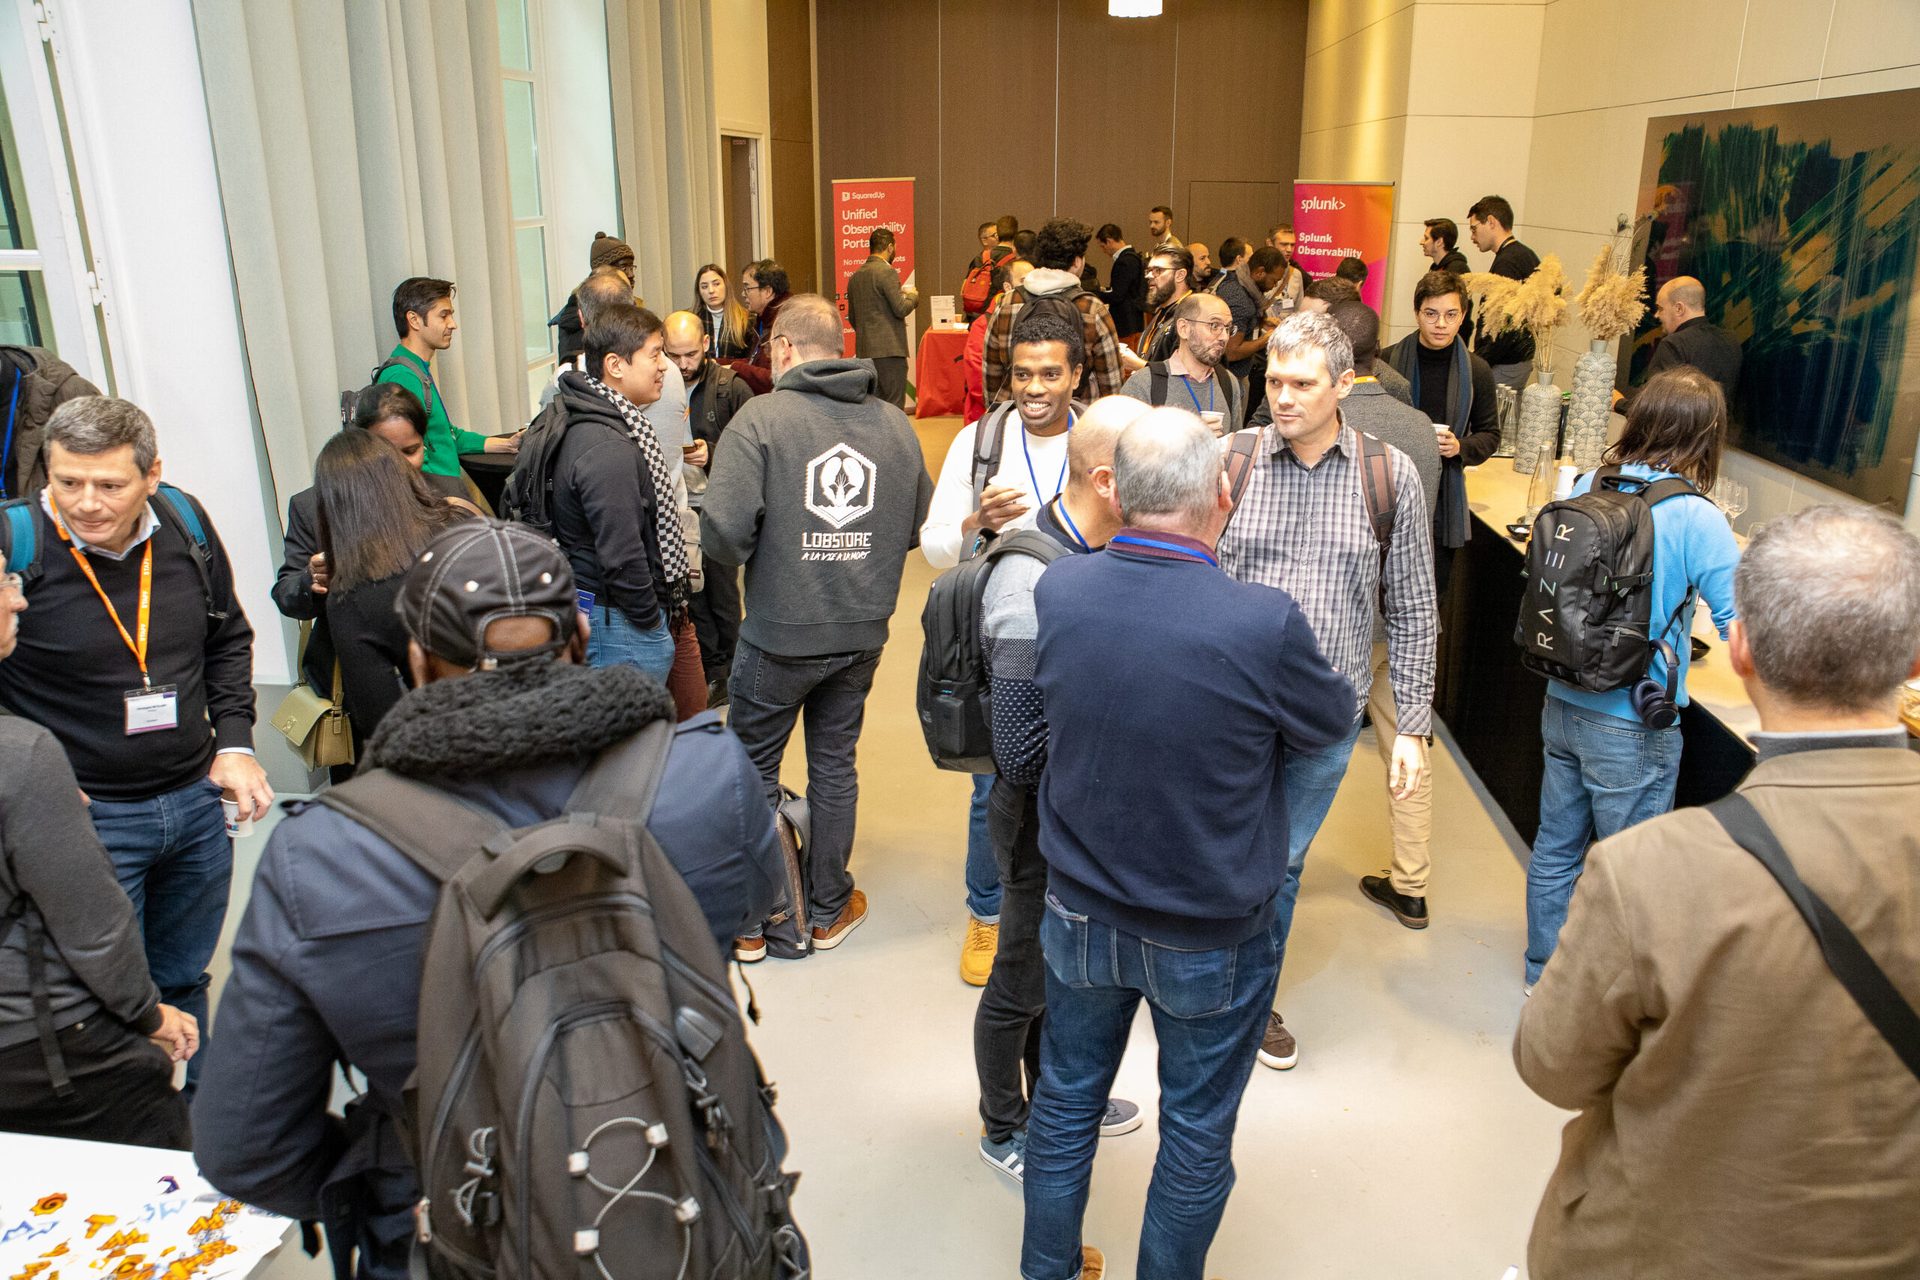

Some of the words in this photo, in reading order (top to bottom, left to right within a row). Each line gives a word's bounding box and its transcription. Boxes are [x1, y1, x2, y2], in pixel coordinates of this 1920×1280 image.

[852, 191, 885, 200] SquaredUp
[842, 208, 878, 220] Unified
[842, 239, 870, 250] Porta
[1299, 232, 1333, 244] Splunk
[1298, 245, 1362, 260] Observability
[854, 257, 866, 265] mor
[802, 532, 872, 548] LOBSTORE
[1537, 523, 1576, 651] RAZER
[141, 591, 149, 609] STAFF
[139, 624, 147, 642] STAFF
